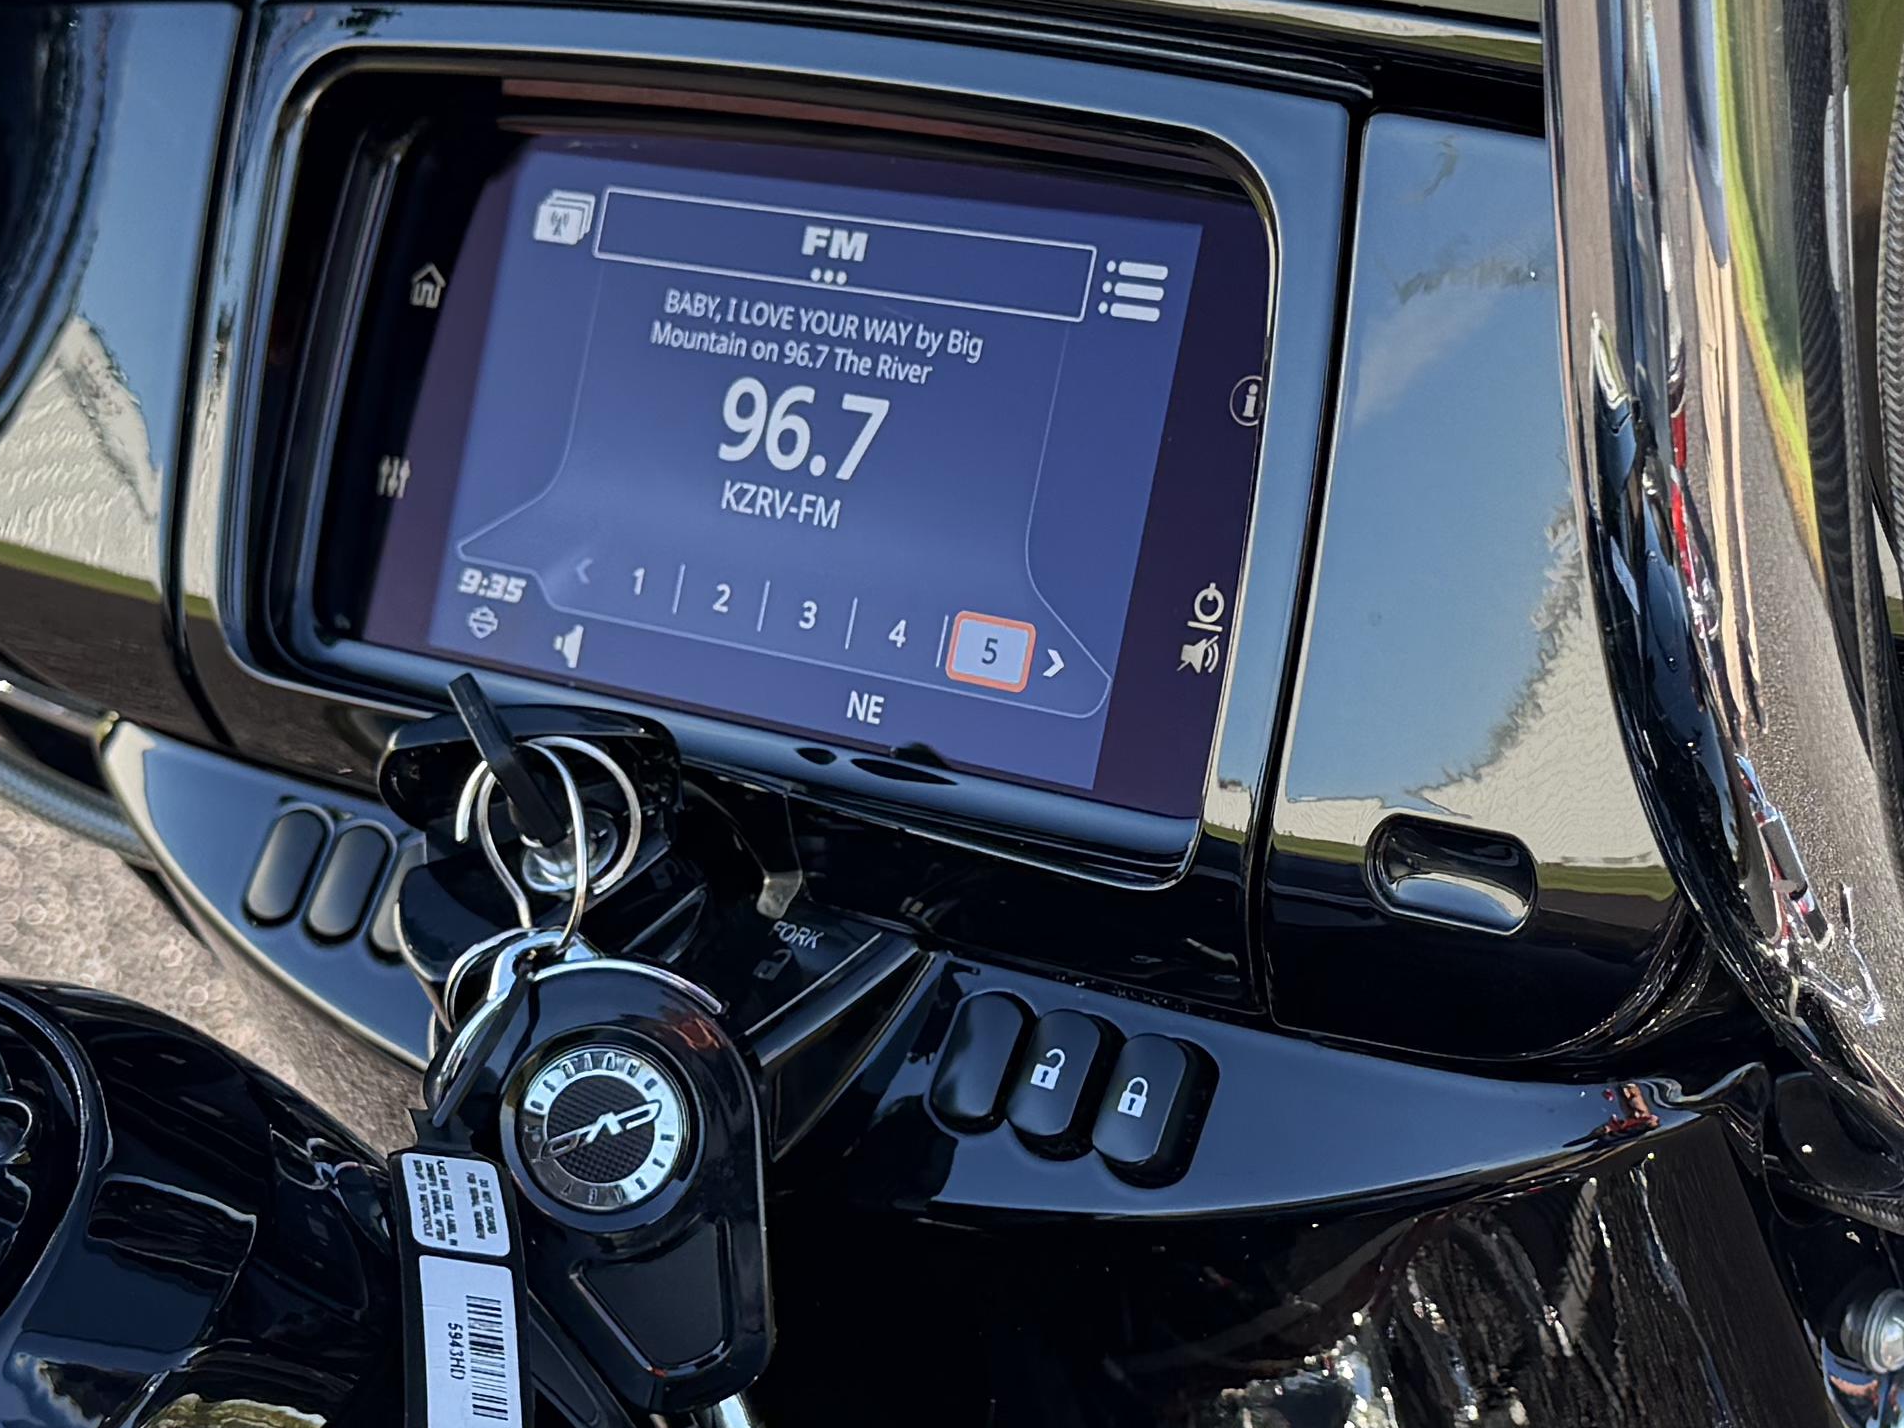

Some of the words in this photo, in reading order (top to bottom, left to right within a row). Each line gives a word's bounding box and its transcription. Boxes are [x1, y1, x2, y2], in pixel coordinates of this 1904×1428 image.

[801, 225, 869, 264] FM
[649, 319, 747, 359] Mountain
[751, 337, 780, 365] on
[783, 338, 831, 371] 96.7
[834, 346, 873, 377] The
[875, 353, 934, 386] River
[664, 287, 722, 323] BABY,
[726, 298, 738, 323] I
[738, 299, 796, 332] LOVE
[798, 307, 860, 340] YOUR
[863, 316, 914, 349] WAY
[915, 323, 944, 358] by
[946, 328, 985, 365] Big
[717, 376, 891, 484] 96.7
[721, 479, 842, 532] KZRV-FM
[457, 567, 528, 604] 9:35
[630, 567, 647, 597] 1
[711, 583, 732, 614] 2
[797, 600, 819, 631] 3
[887, 618, 908, 649] 4
[979, 636, 1000, 667] 5
[845, 690, 886, 725] NE
[771, 920, 825, 950] FORK
[540, 1099, 663, 1161] CVO
[447, 1321, 467, 1381] 5943HD
